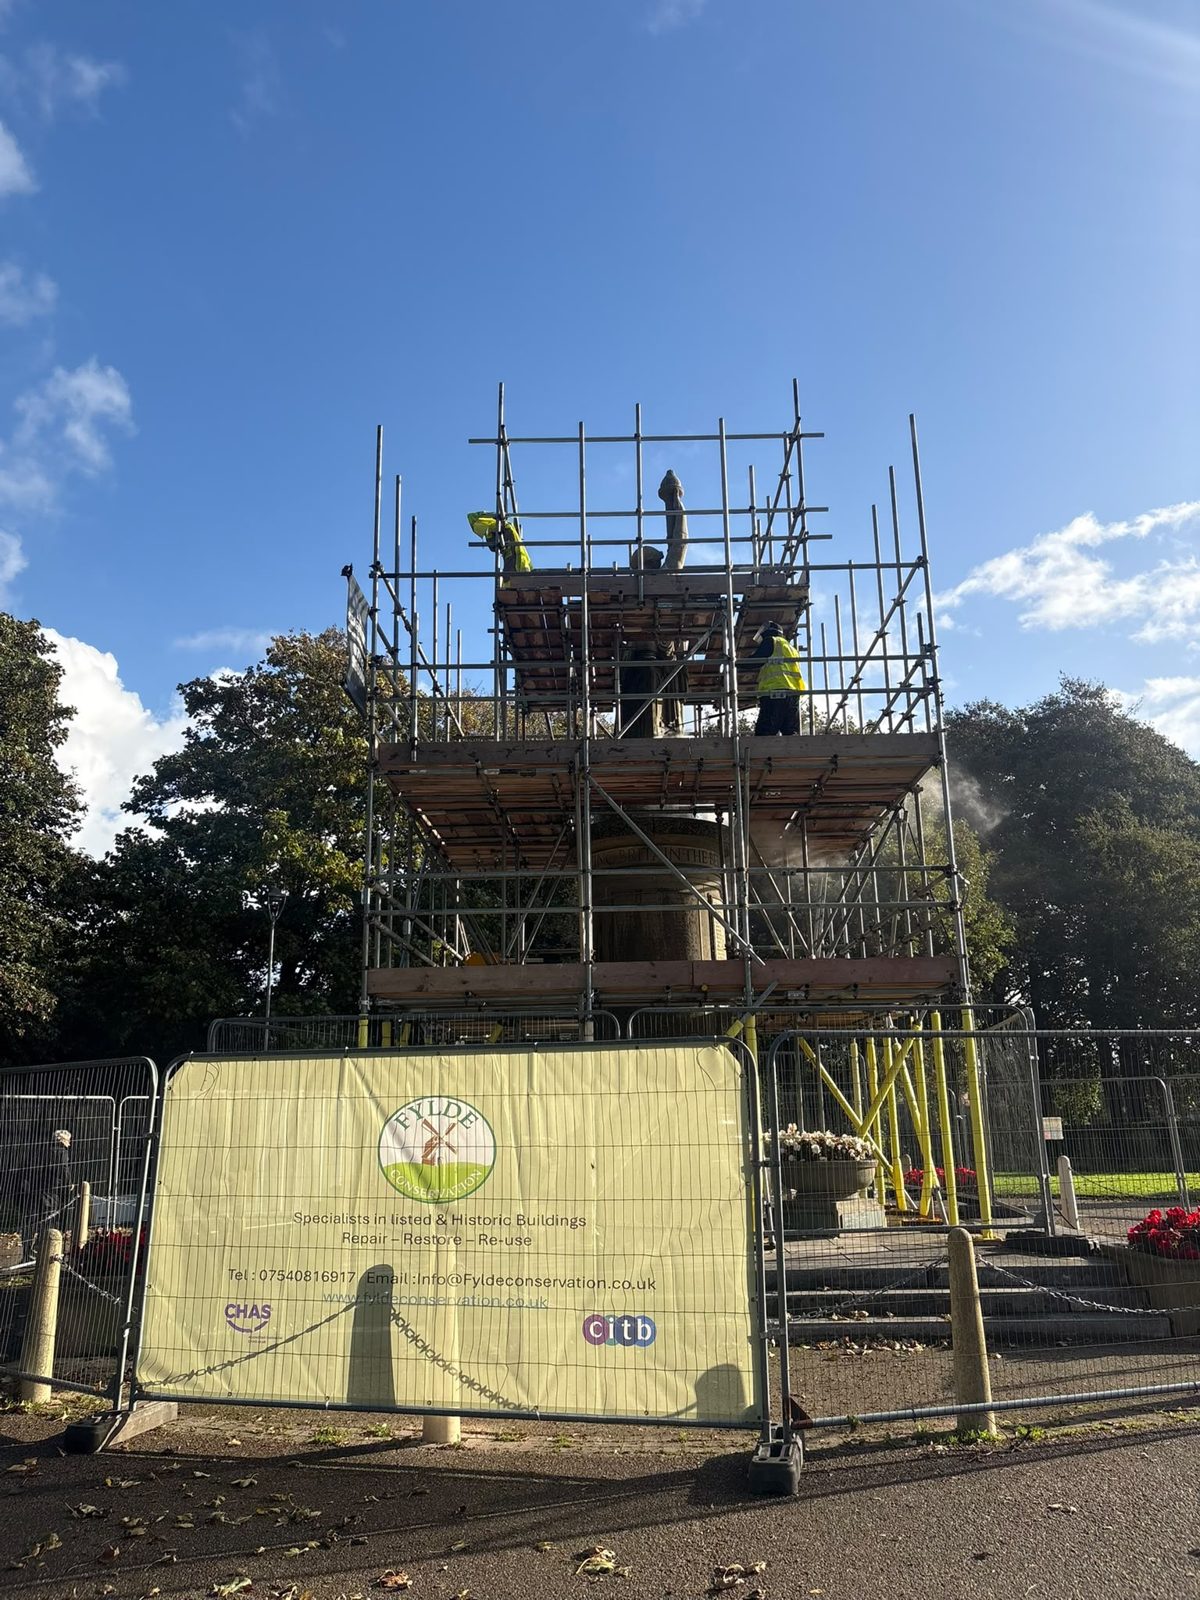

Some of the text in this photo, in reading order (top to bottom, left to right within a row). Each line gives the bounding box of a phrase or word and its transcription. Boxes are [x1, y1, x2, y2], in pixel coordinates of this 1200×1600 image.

[393, 1100, 479, 1131] FYLDE
[390, 1169, 482, 1200] CONSERVATION
[293, 1211, 587, 1230] Specialists in listed & Historic Buildings
[342, 1231, 388, 1246] Repair
[403, 1233, 462, 1246] Restore
[478, 1233, 533, 1247] Re-use
[259, 1269, 356, 1283] 07540816917
[323, 1292, 549, 1309] www.fyldeconservation.co.uk
[224, 1303, 272, 1319] CHAS
[588, 1316, 653, 1341] citb
